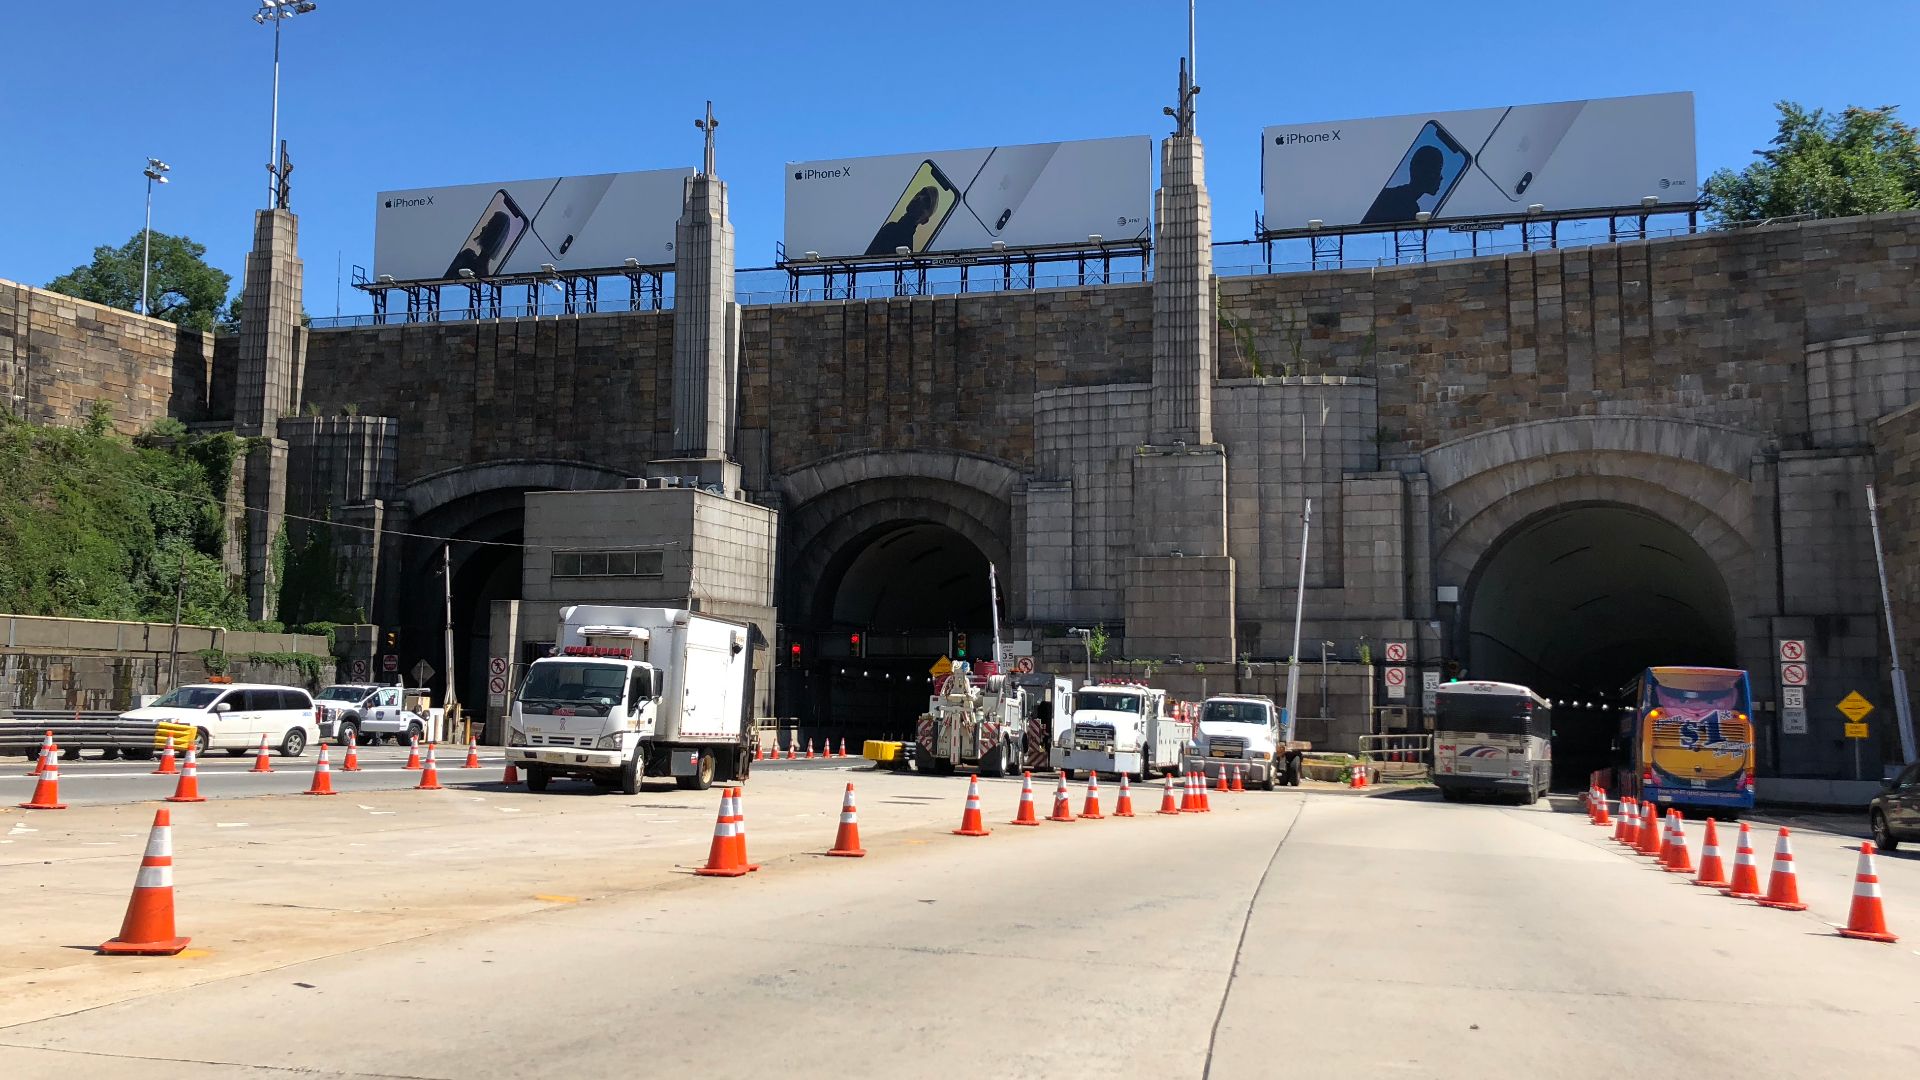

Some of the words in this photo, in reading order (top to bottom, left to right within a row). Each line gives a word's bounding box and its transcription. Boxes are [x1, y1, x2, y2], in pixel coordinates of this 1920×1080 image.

[1286, 133, 1330, 145] iPhone
[1332, 129, 1341, 141] X
[804, 169, 841, 180] iPhone
[842, 166, 851, 177] X
[393, 197, 426, 208] iPhone
[426, 195, 435, 206] X
[1002, 652, 1014, 660] 35
[1785, 697, 1801, 706] 35
